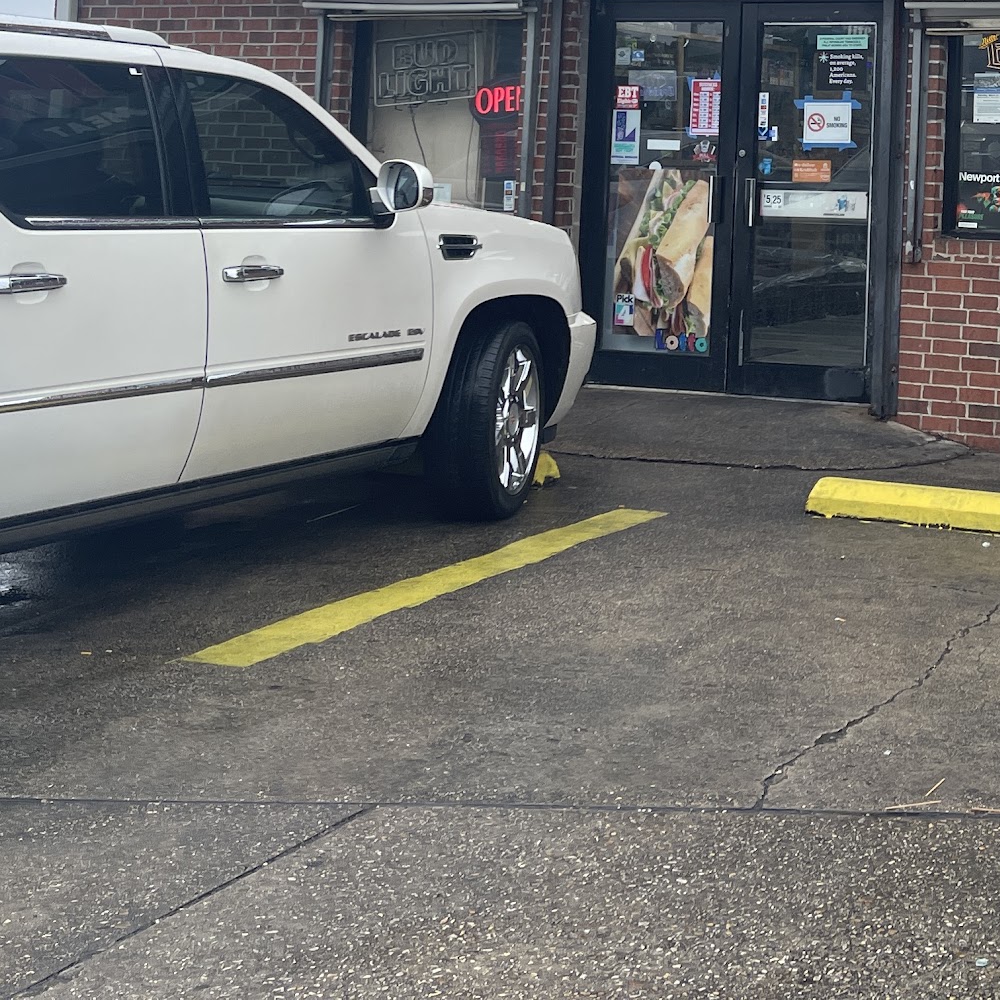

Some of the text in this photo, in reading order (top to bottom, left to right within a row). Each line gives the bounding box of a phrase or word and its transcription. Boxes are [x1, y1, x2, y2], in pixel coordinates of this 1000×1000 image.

[391, 38, 459, 71] BUD
[378, 64, 472, 99] LIGHT
[617, 86, 639, 98] EBT
[958, 171, 1000, 184] Newport
[616, 294, 634, 303] Pick
[616, 304, 634, 325] 4
[347, 329, 402, 342] ESCALADE
